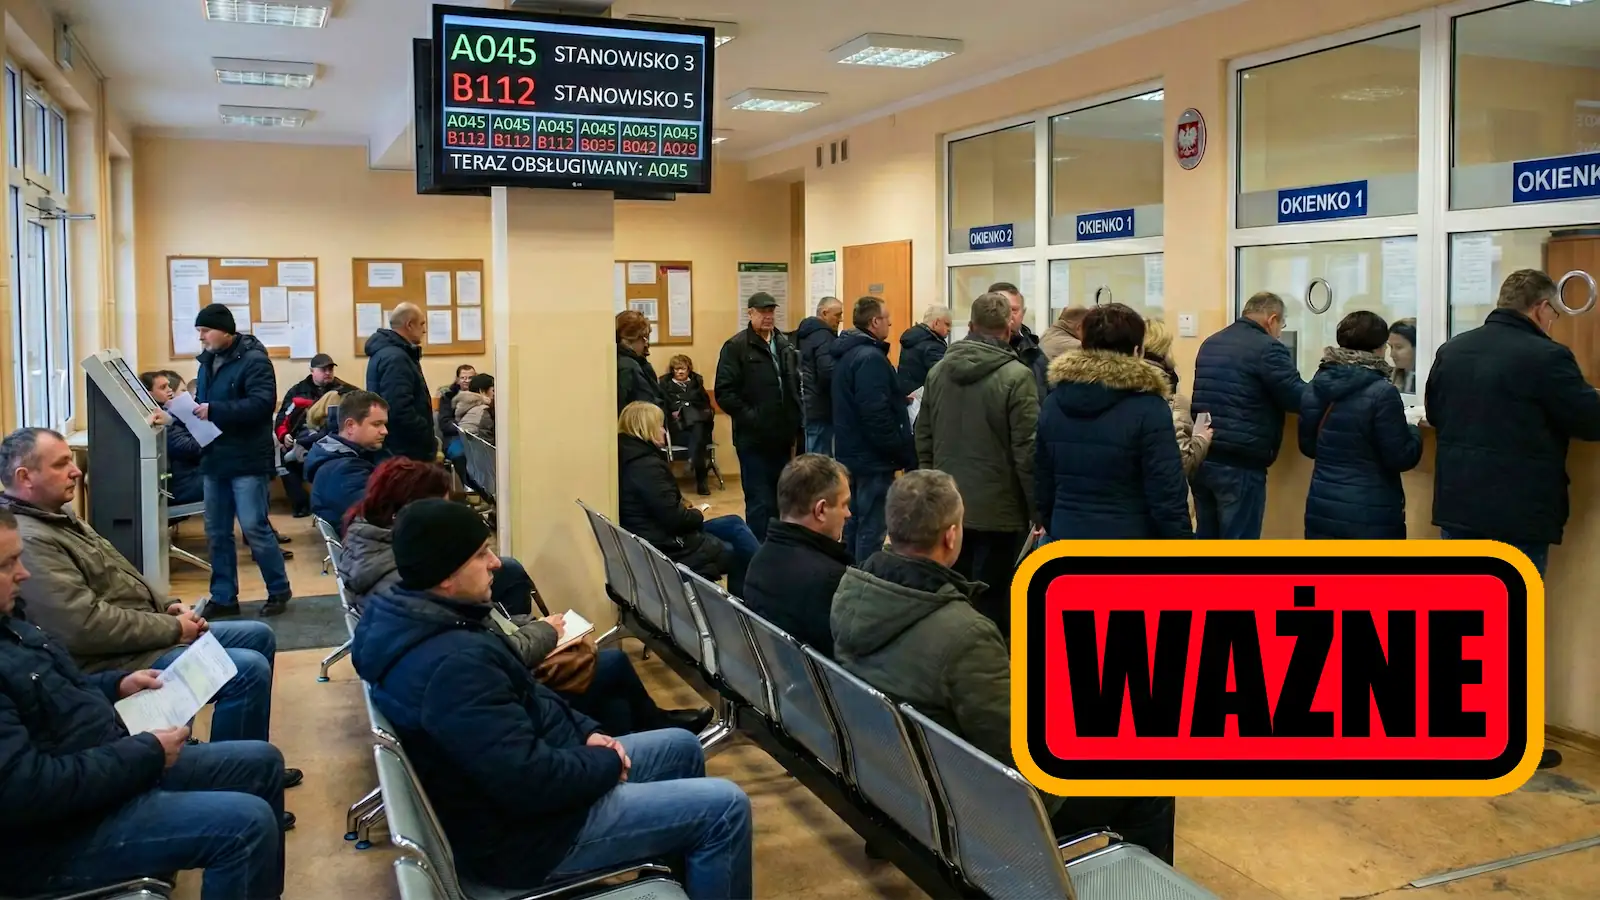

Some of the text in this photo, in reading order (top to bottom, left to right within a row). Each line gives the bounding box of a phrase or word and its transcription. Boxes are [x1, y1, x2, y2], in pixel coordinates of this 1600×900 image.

[450, 34, 694, 71] A045 STANOWISKO 3
[453, 73, 694, 109] B112 STANOWISKO 5
[447, 114, 697, 140] A045 A045 A045 A045 A045 A045
[493, 133, 530, 148] B112
[537, 136, 574, 150] B112
[580, 138, 616, 152] B035
[622, 140, 657, 154] B042
[450, 153, 688, 178] TERAZ OBSŁUGIWANY: A045
[1281, 189, 1363, 214] OKIENKO 1
[970, 229, 1012, 245] OKIENKO 2
[1078, 215, 1132, 235] OKIENKO 1
